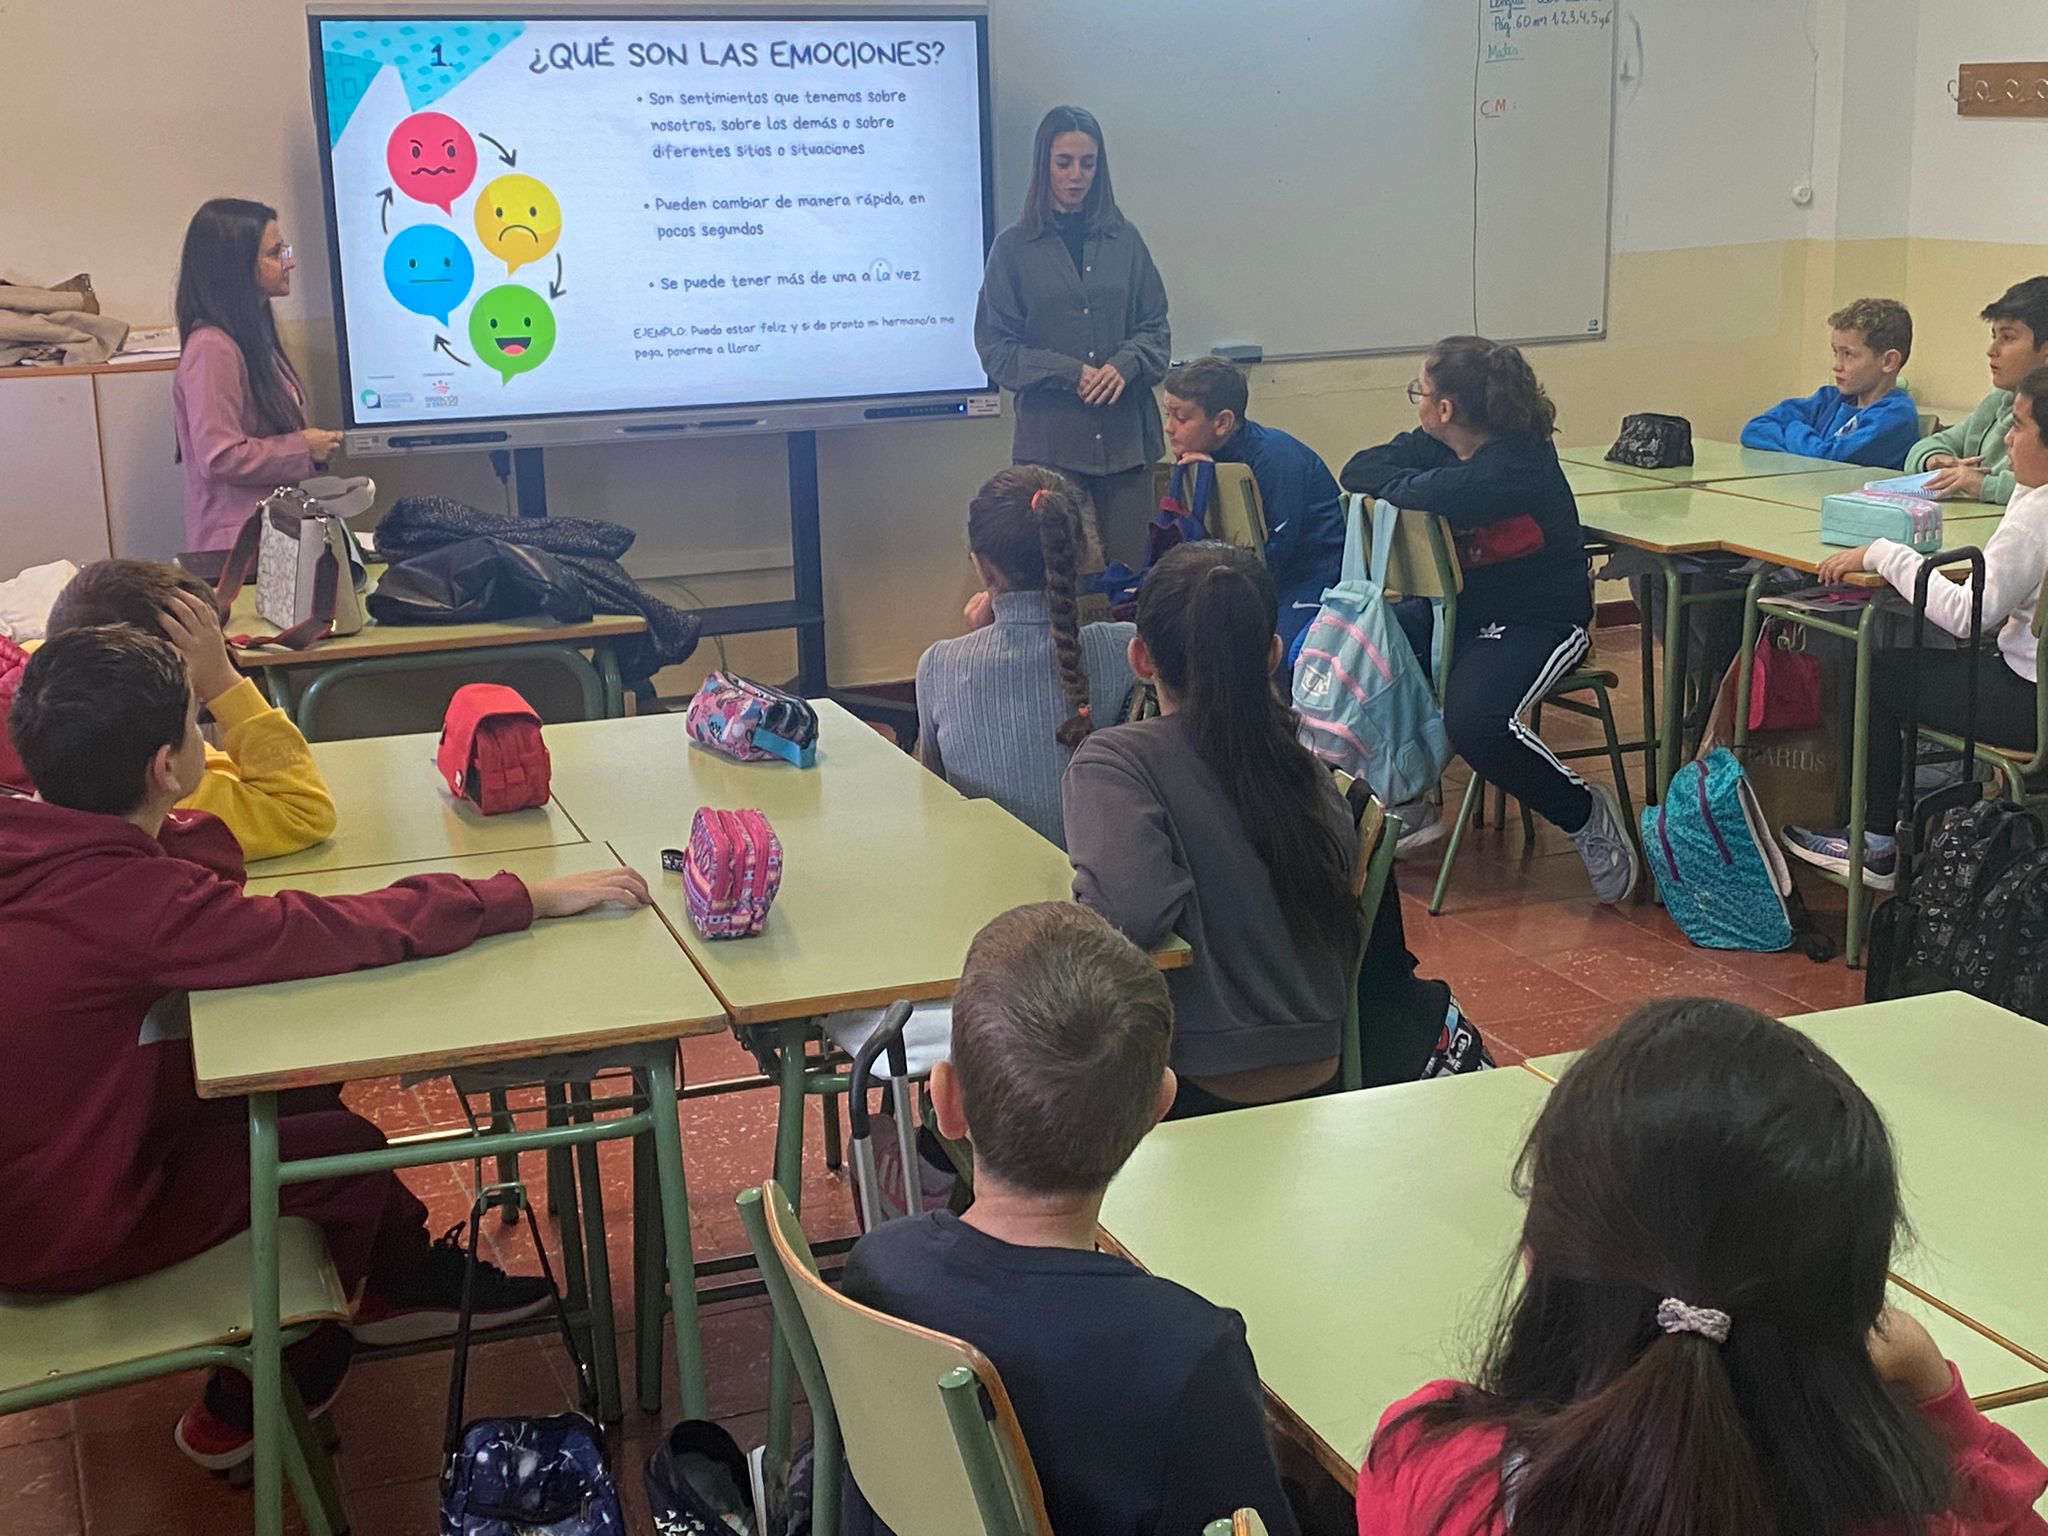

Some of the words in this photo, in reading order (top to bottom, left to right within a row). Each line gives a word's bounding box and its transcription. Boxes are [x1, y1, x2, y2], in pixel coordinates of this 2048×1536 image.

[529, 36, 615, 74] ¿QUÉ
[628, 42, 688, 67] SON
[700, 42, 758, 67] LAS
[770, 40, 945, 69] EMOCIONES?
[649, 92, 674, 105] Son
[680, 91, 768, 105] sentimientos
[774, 92, 799, 106] que
[805, 91, 862, 104] tenemos
[868, 89, 906, 103] sobre
[651, 119, 716, 132] nosotros,
[721, 117, 761, 131] sobre
[767, 115, 787, 130] los
[793, 115, 837, 130] demás
[843, 120, 850, 129] o
[856, 115, 895, 129] sobre
[653, 144, 731, 159] diferentes
[737, 145, 772, 158] sitios
[778, 146, 785, 156] o
[791, 143, 865, 157] situaciones
[655, 196, 706, 211] Pueden
[712, 196, 770, 209] cambiar
[775, 195, 792, 208] de
[798, 195, 851, 208] manera
[855, 191, 904, 208] rápida,
[909, 194, 926, 205] en
[657, 226, 696, 241] pocos
[701, 221, 764, 240] segundos
[660, 277, 678, 290] Se
[684, 274, 725, 292] puede
[731, 275, 771, 288] tener
[777, 272, 805, 286] más
[810, 271, 827, 284] de
[832, 272, 857, 283] una
[862, 272, 871, 282] a
[875, 267, 891, 282] la
[896, 270, 921, 281] vez
[691, 325, 722, 336] Puedo
[726, 323, 756, 334] estar
[761, 321, 787, 334] feliz
[791, 323, 798, 334] y
[813, 320, 826, 331] de
[830, 320, 864, 332] pronto
[882, 315, 936, 327] hermano/a
[667, 346, 713, 358] ponerme
[717, 346, 725, 354] a
